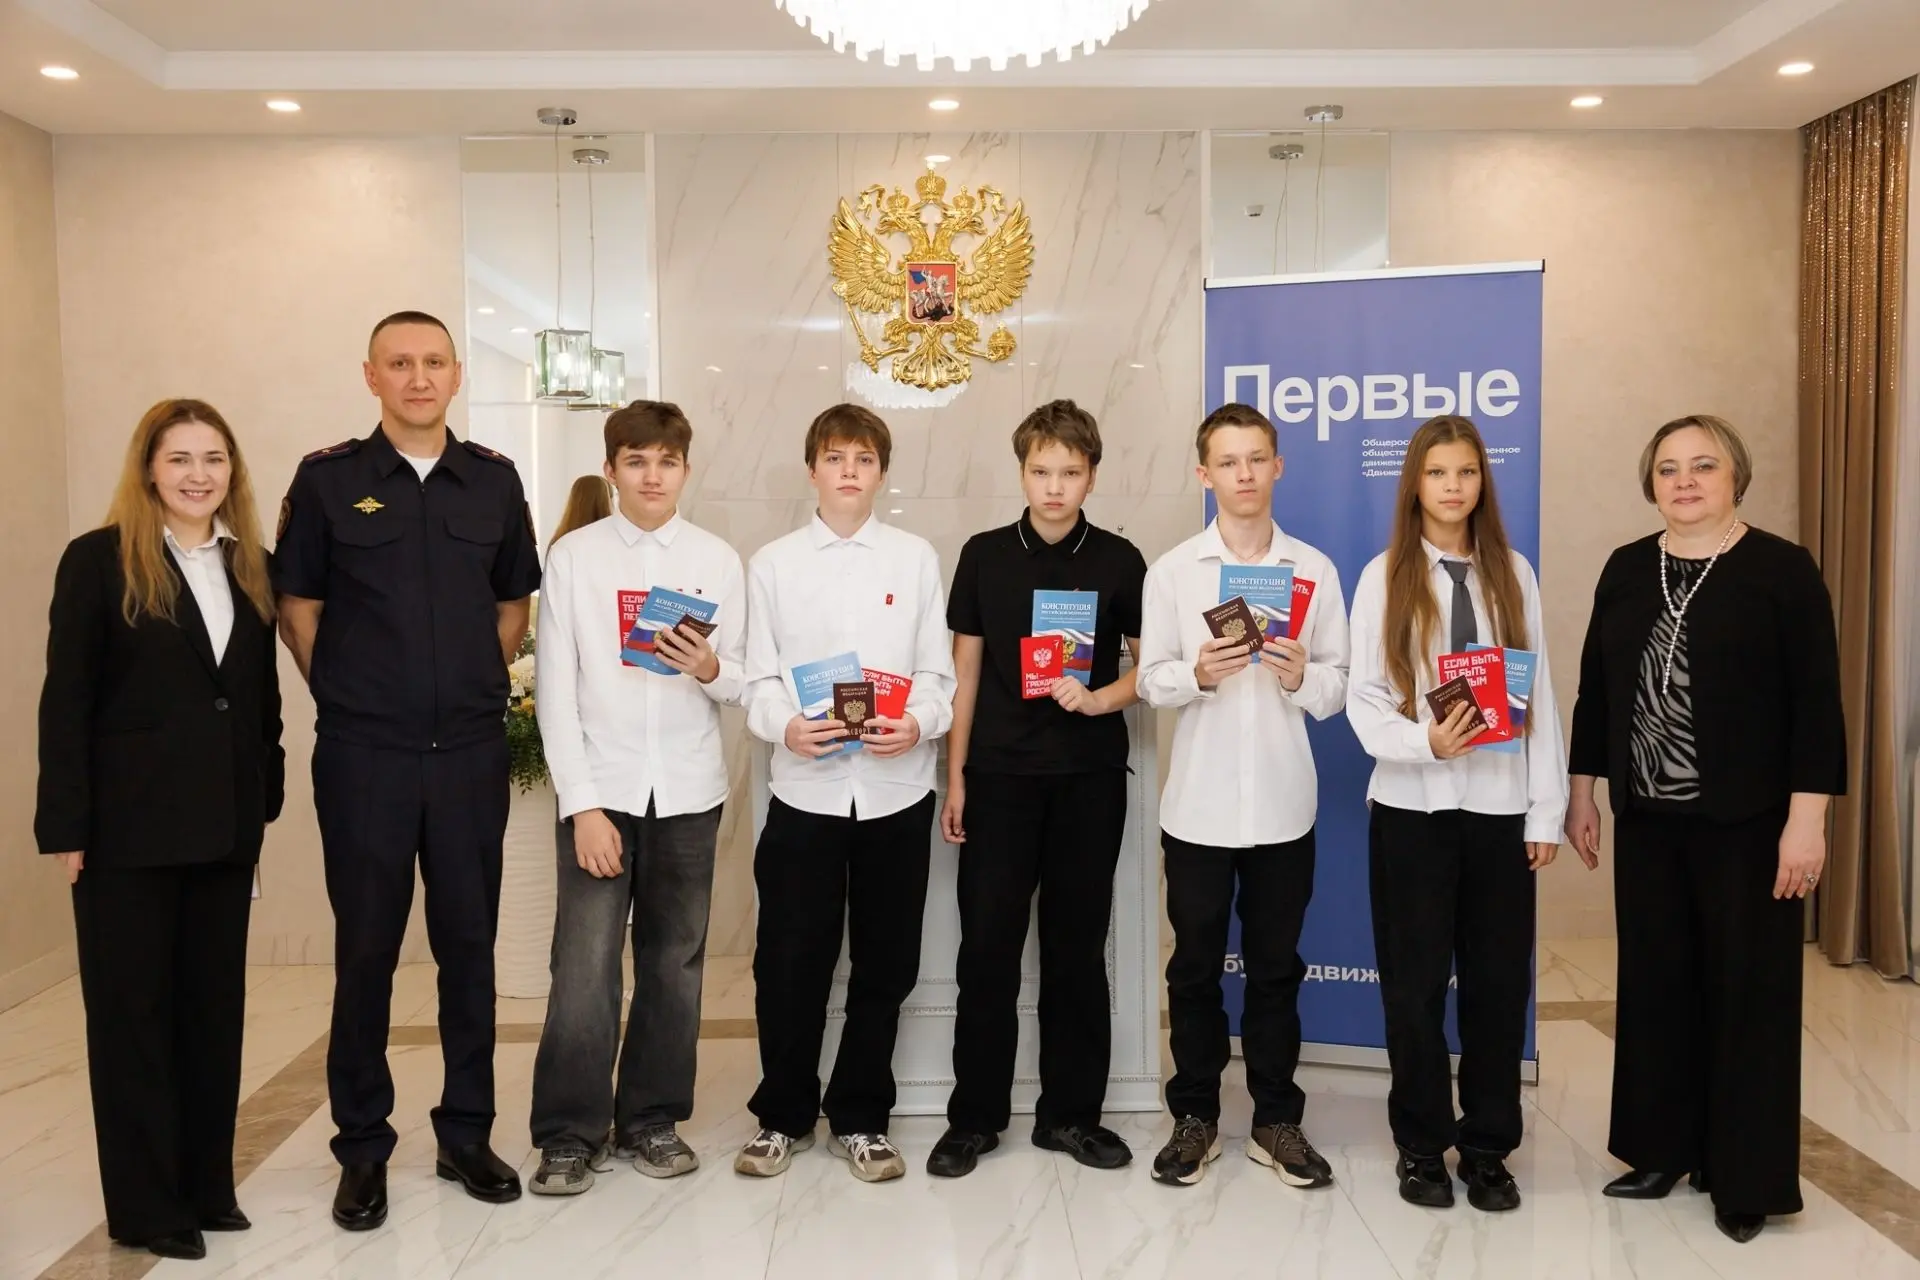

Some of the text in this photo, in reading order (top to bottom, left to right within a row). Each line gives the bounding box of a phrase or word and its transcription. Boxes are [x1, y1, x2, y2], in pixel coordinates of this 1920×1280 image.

[1224, 364, 1520, 441] Первые
[1229, 578, 1286, 587] КОНСТИТУЦИЯ
[1041, 603, 1091, 611] КОНСТИТУЦИЯ
[1444, 657, 1470, 669] ЕСЛИ
[1026, 672, 1039, 680] МЫ
